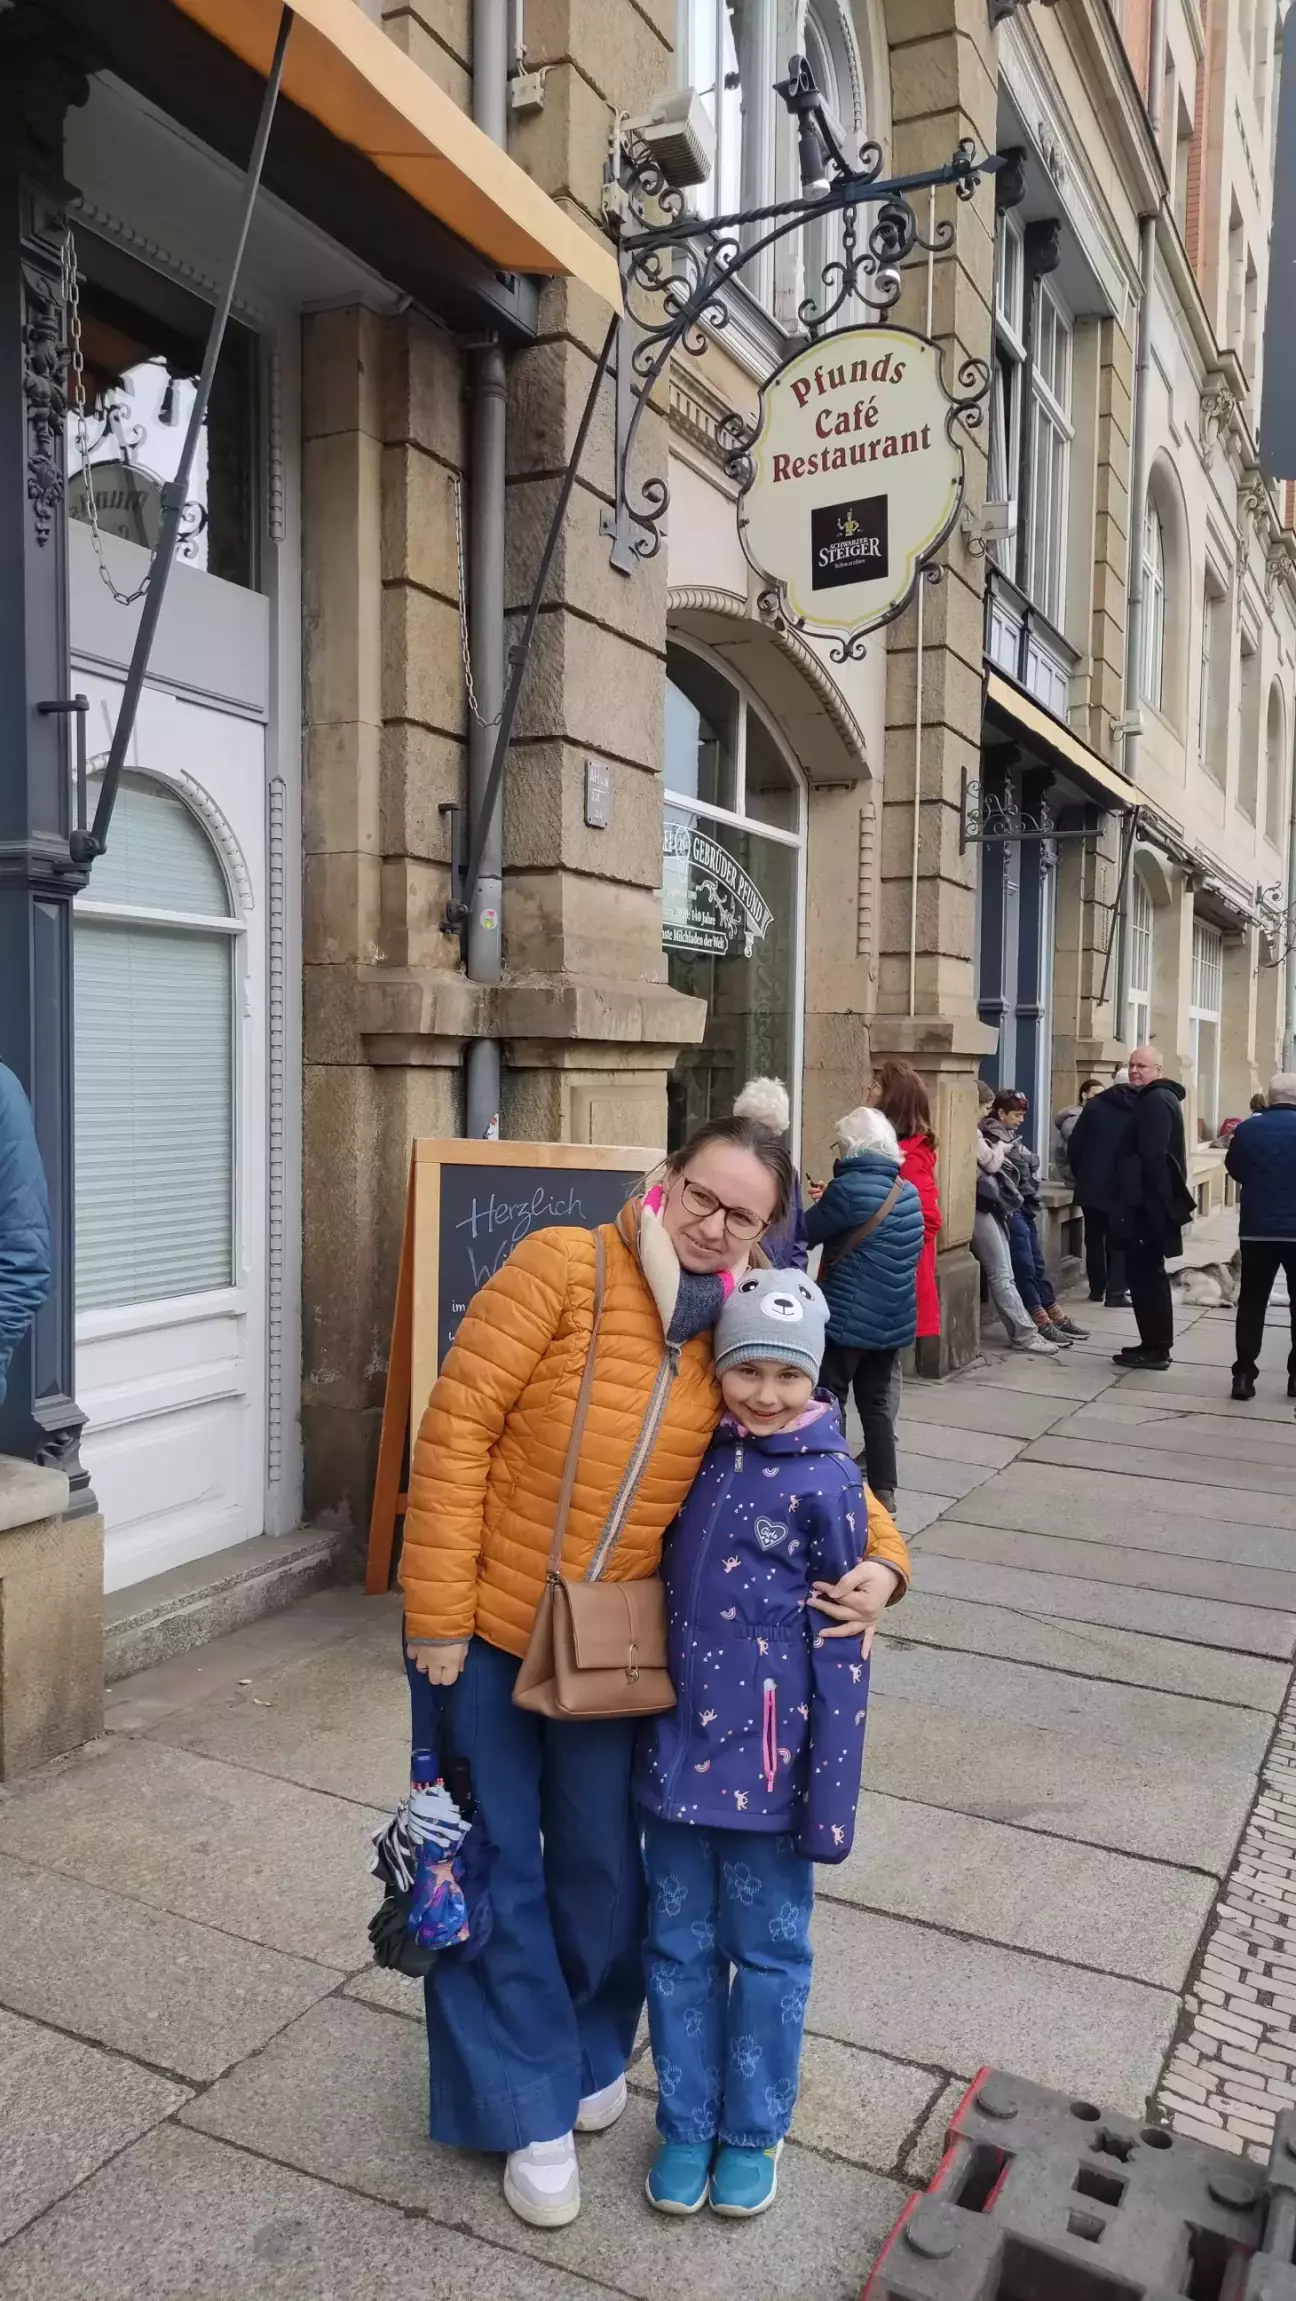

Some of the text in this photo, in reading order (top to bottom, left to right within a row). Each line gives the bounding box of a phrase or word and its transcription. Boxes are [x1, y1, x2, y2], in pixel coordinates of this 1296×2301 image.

[790, 353, 907, 408] Pfunds
[815, 395, 879, 439] Café
[772, 424, 931, 482] Restaurant
[818, 537, 882, 567] STEIGER
[829, 537, 868, 550] SCHWARZER
[693, 837, 737, 890] GEBRÜDER
[738, 874, 763, 922] PFUND
[455, 1187, 586, 1242] Herzlich
